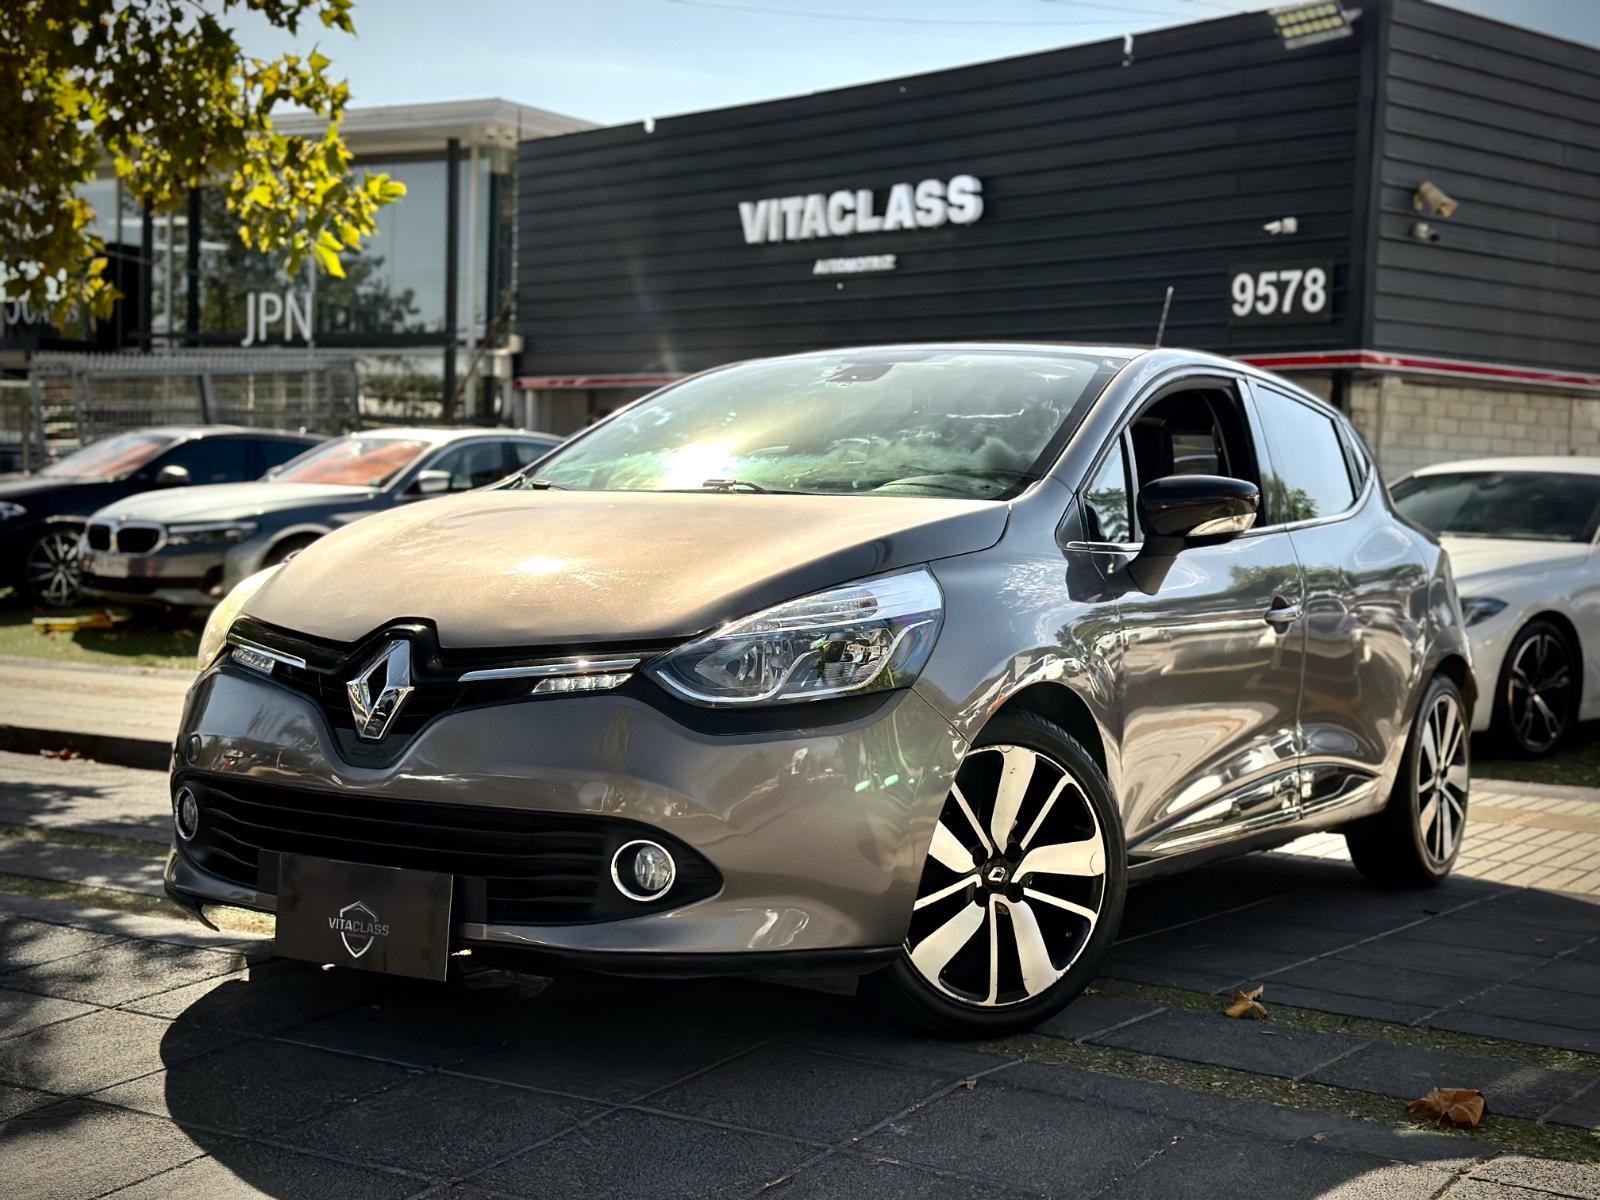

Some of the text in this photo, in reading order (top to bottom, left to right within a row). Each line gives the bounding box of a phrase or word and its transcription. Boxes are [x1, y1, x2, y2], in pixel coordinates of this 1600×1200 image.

[738, 174, 984, 244] VITACLASS
[1231, 266, 1327, 317] 9578
[241, 291, 313, 347] JPN
[328, 916, 390, 937] VITACLASS
